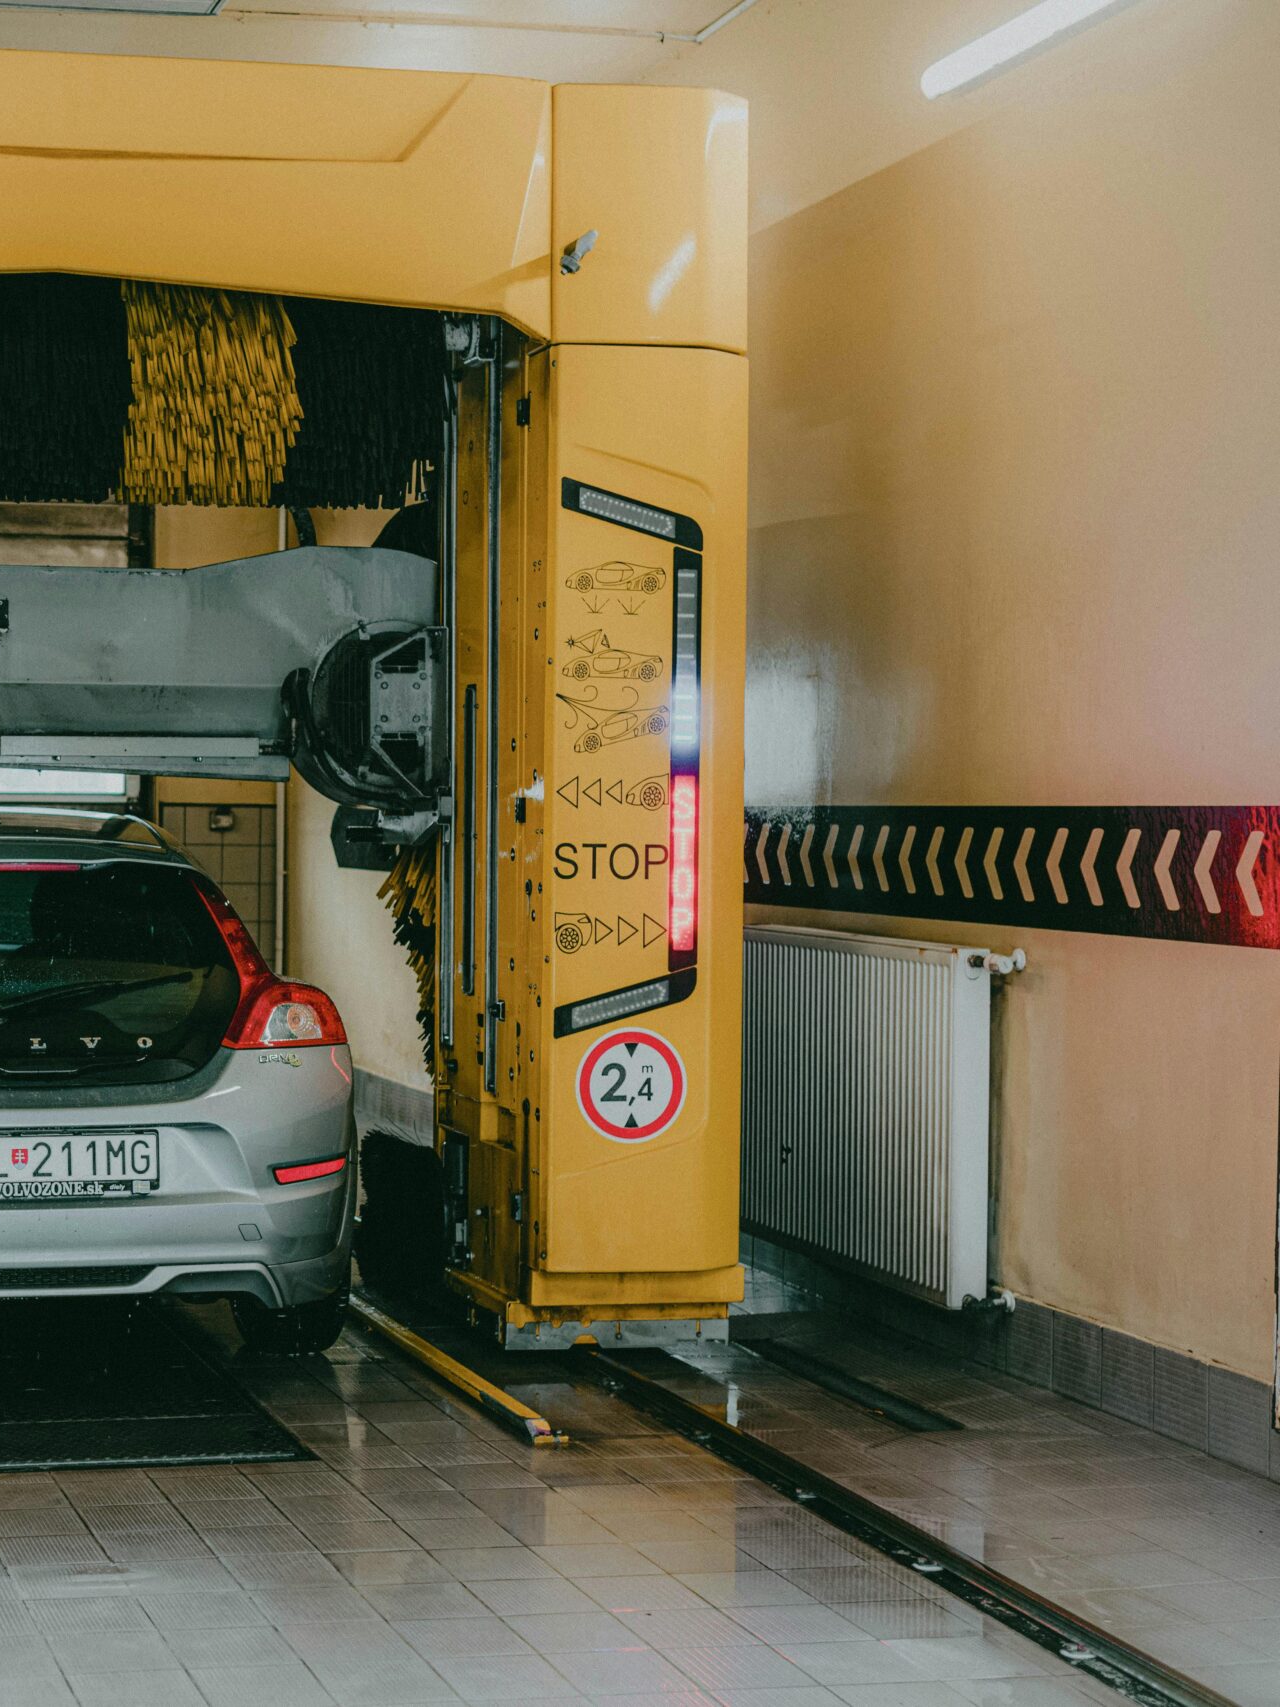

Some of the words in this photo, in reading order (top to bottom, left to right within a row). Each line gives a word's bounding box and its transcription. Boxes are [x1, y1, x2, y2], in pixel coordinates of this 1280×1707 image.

[553, 842, 669, 880] STOP
[672, 787, 696, 943] STOP
[32, 1140, 151, 1177] 211MG
